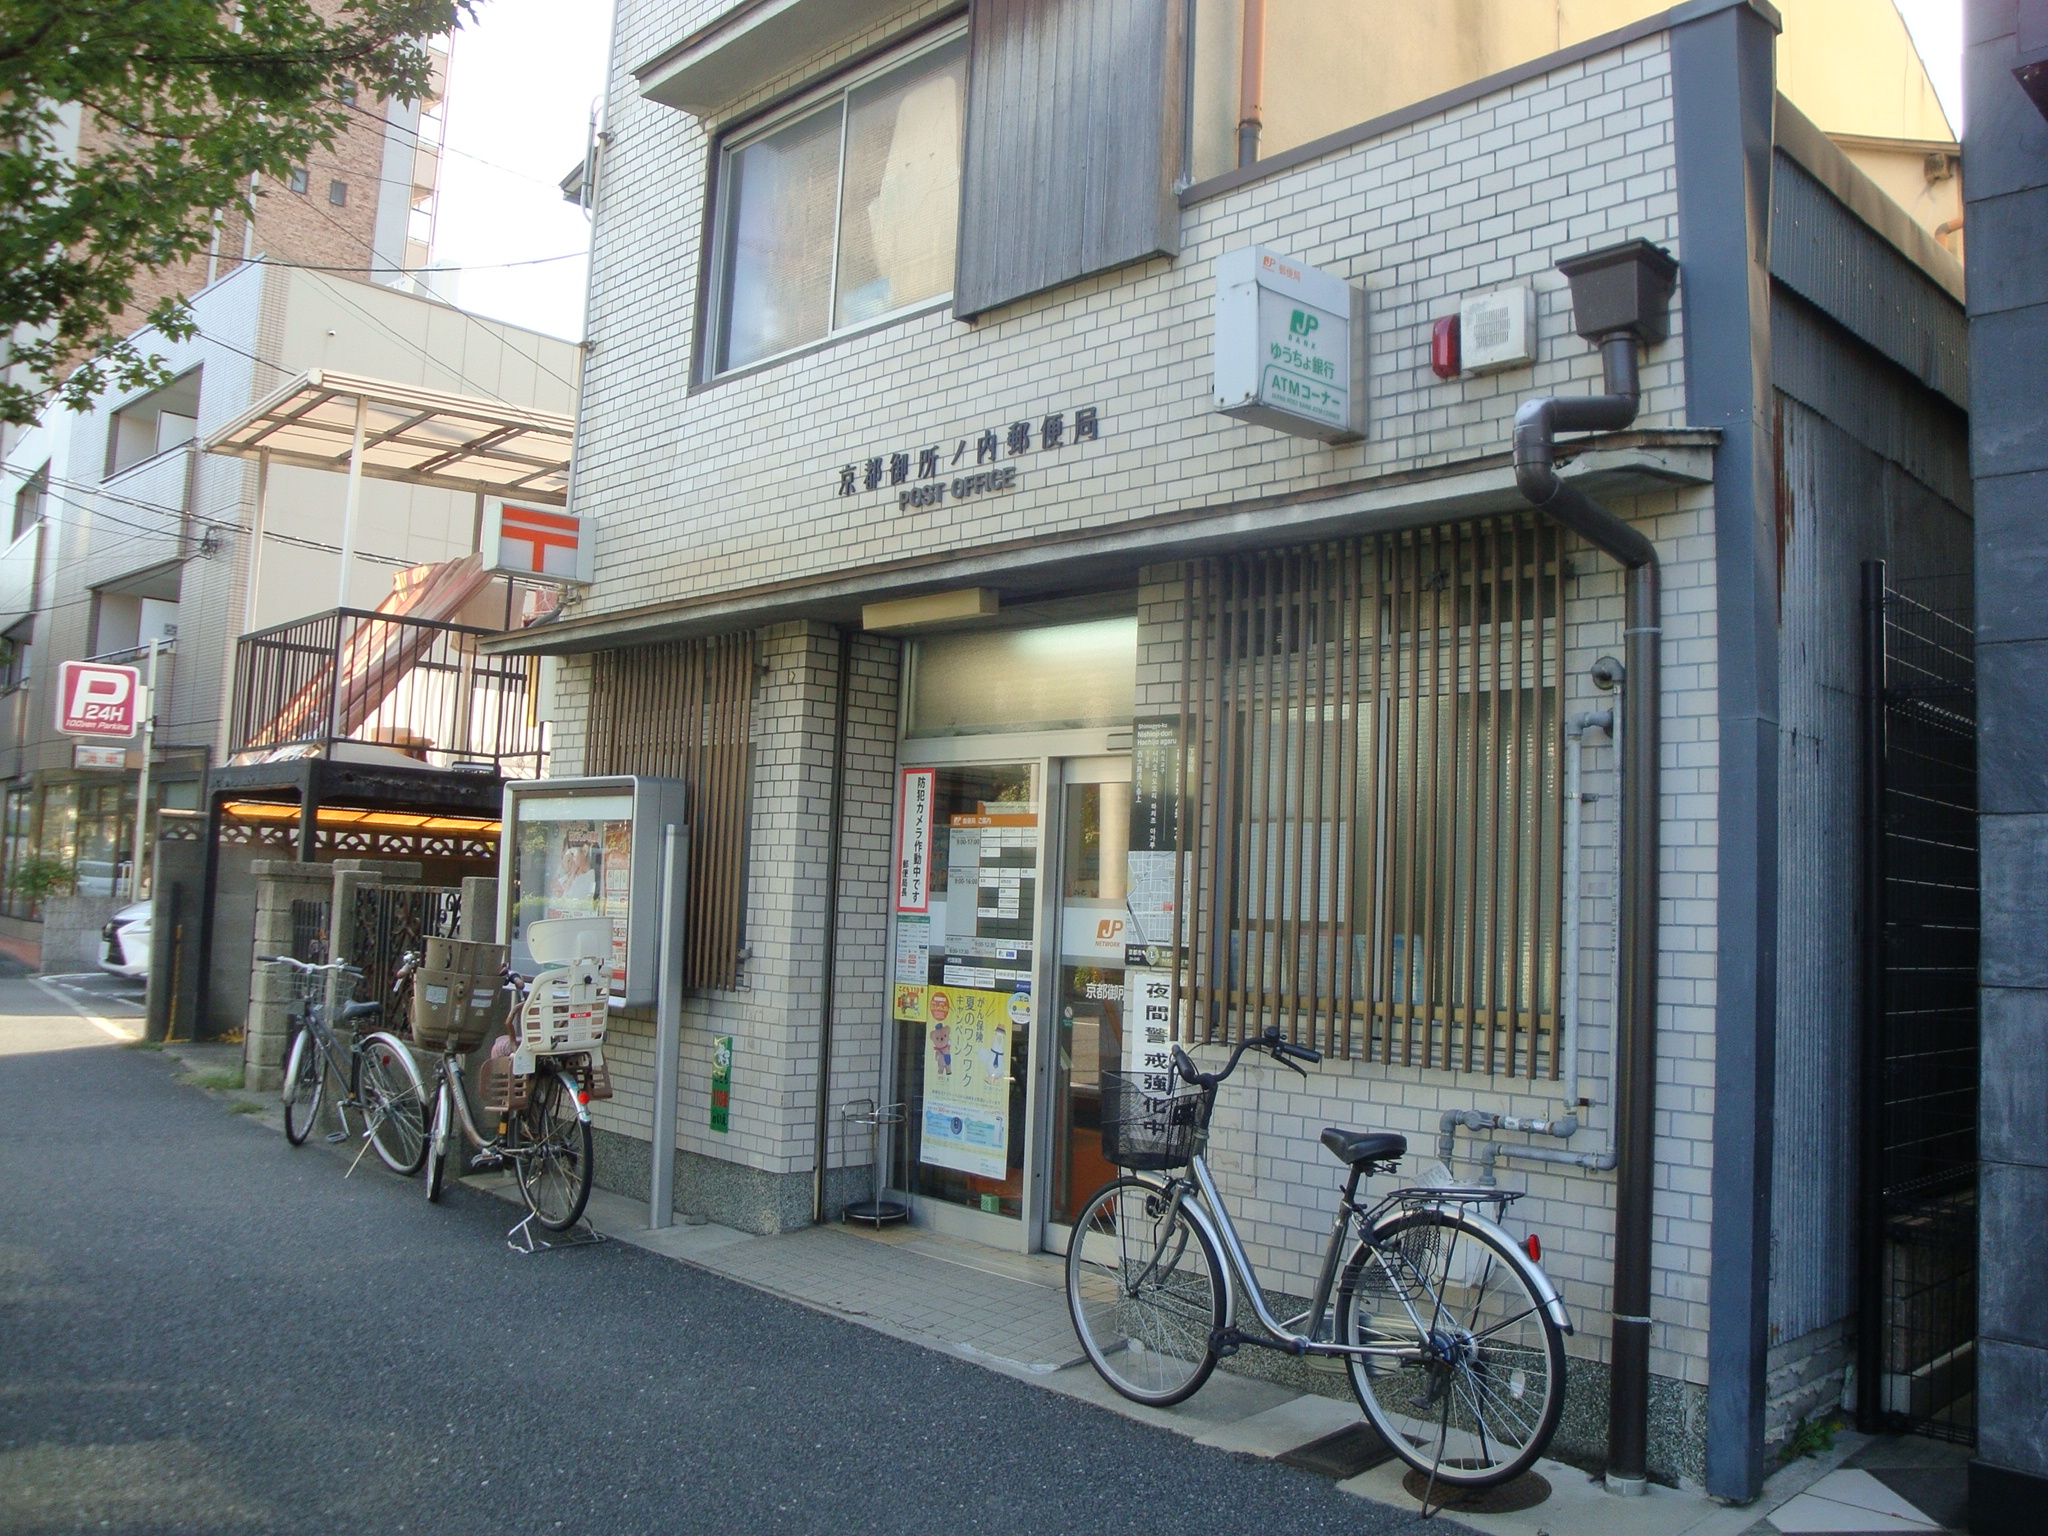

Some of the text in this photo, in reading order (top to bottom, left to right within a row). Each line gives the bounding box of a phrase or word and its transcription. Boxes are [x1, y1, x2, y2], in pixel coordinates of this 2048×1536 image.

[1271, 342, 1335, 379] ゆうちょ銀行
[1288, 333, 1316, 349] BANK
[1271, 374, 1340, 405] ATMコーナー
[838, 406, 1099, 497] 京都御所ノ内郵便局
[899, 466, 1017, 511] POST OFFICE
[70, 670, 130, 718] P
[85, 705, 125, 721] 24H
[911, 776, 926, 903] 防犯カメラ作動中です
[901, 859, 909, 897] 郵便局長
[1095, 940, 1121, 948] NETWORK
[954, 995, 964, 1056] キャンペーン
[963, 995, 975, 1087] 夏のワクワク
[976, 997, 985, 1043] がん保険
[1143, 982, 1170, 1135] 夜間警戒強化中
